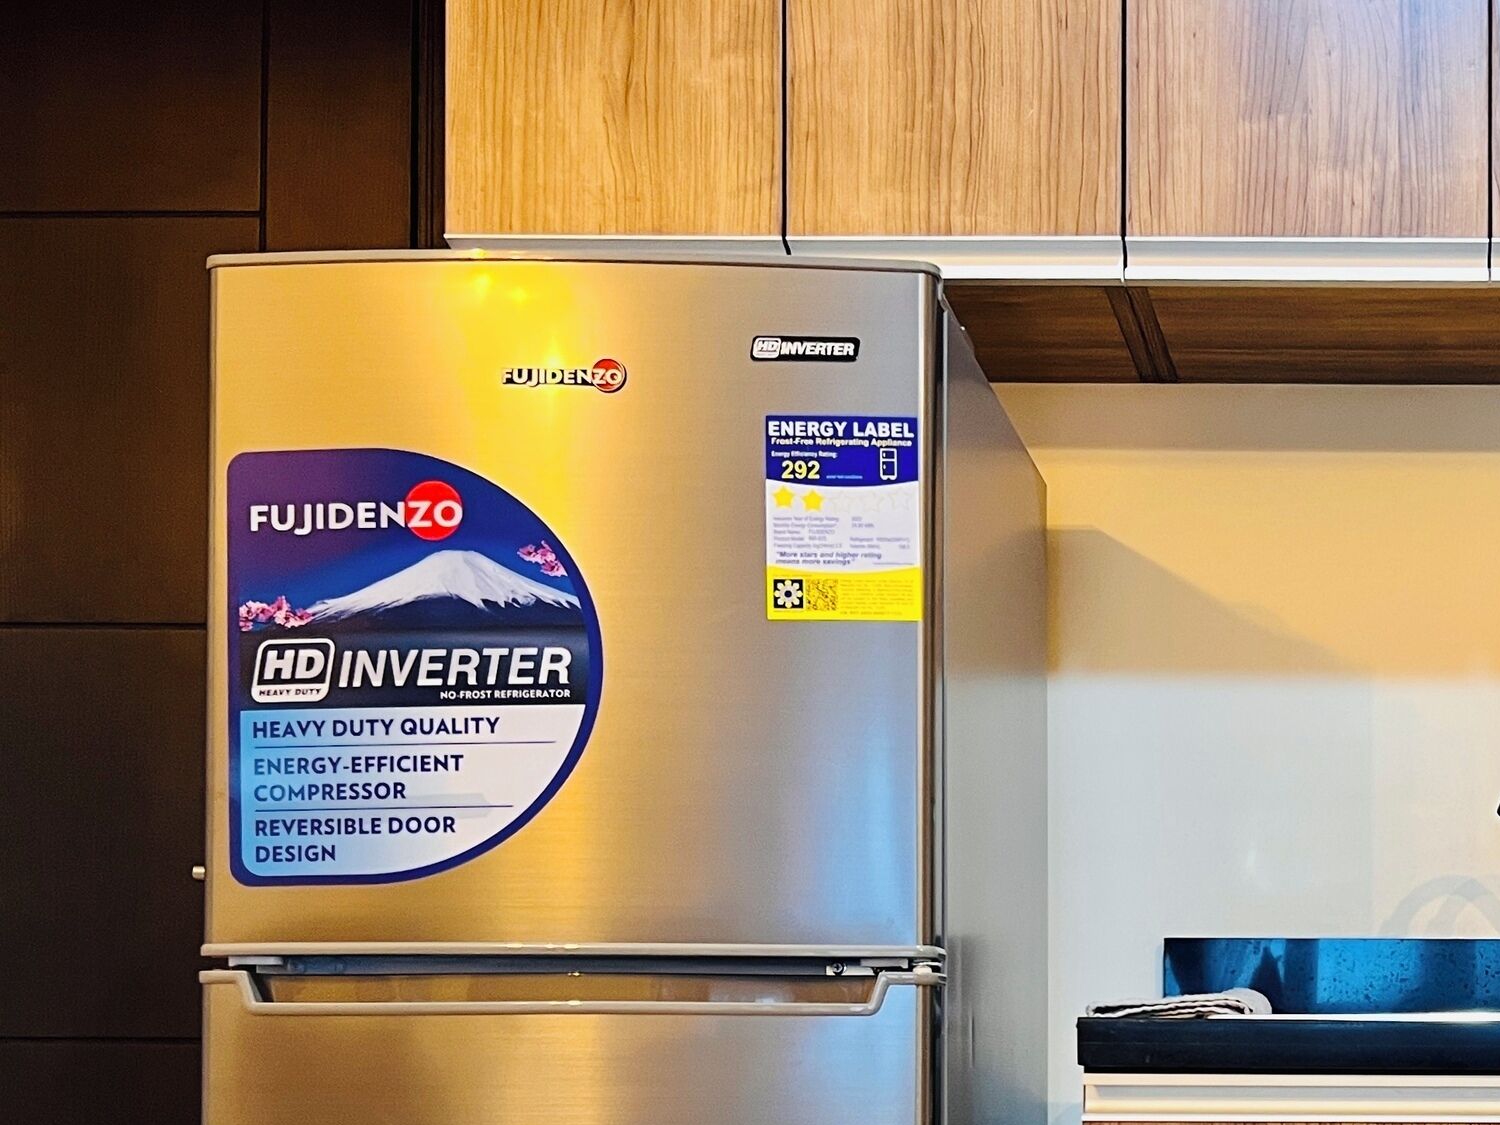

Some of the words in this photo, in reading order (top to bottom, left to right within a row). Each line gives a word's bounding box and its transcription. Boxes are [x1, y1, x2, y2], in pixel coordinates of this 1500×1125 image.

[758, 340, 777, 351] HD
[780, 341, 855, 356] INVERTER
[502, 368, 623, 387] FUJIDENZO
[768, 421, 847, 437] ENERGY
[853, 422, 914, 438] LABEL
[771, 437, 814, 445] Frost-Free
[815, 437, 869, 447] Refrigerating
[870, 438, 912, 447] Appliance
[781, 460, 820, 479] 292
[250, 501, 463, 535] FUJIDENZO
[263, 648, 325, 680] HD
[338, 647, 572, 688] INVERTER
[440, 689, 493, 700] NO-FROST
[494, 688, 571, 699] REFRIGERATOR
[252, 719, 326, 738] HEAVY
[331, 718, 394, 737] DUTY
[400, 716, 501, 735] QUALITY
[253, 754, 464, 775] ENERGY-EFFICIENT
[253, 782, 406, 802] COMPRESSOR
[255, 817, 382, 837] REVERSIBLE
[388, 816, 456, 834] DOOR
[255, 844, 336, 863] DESIGN
